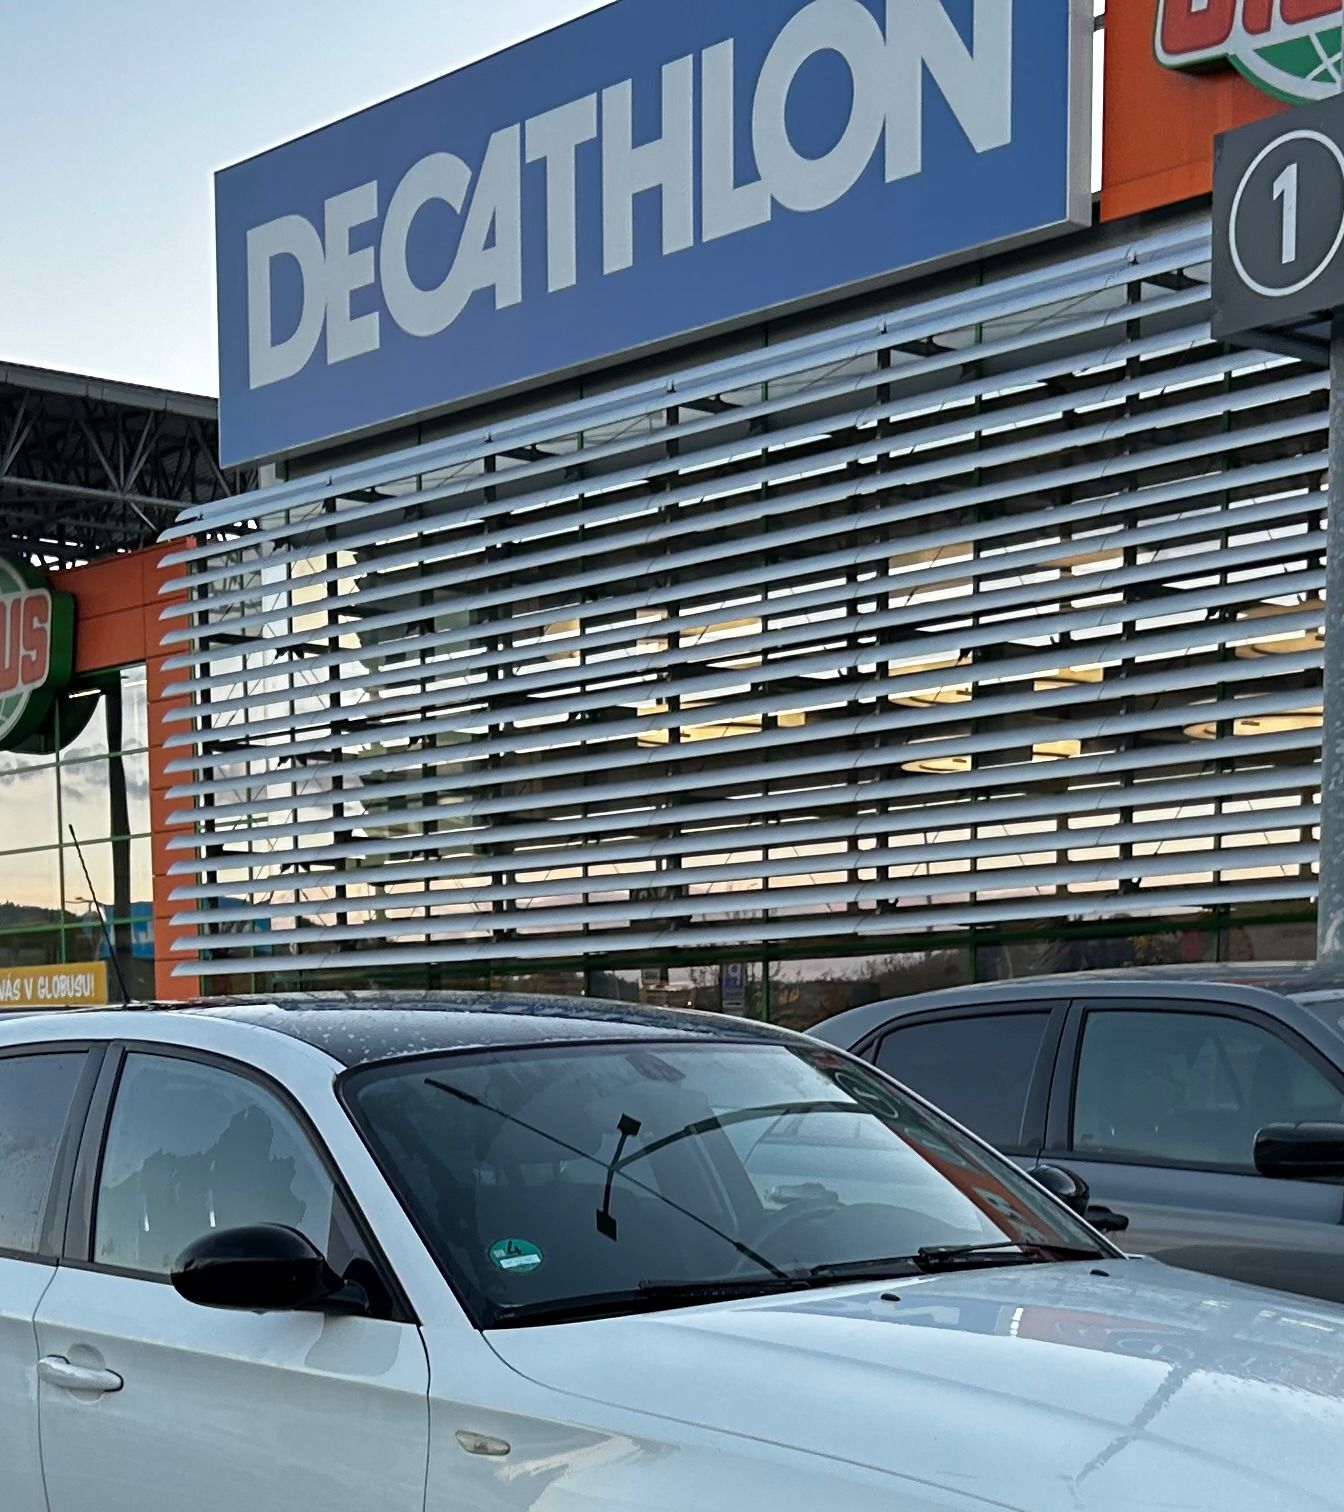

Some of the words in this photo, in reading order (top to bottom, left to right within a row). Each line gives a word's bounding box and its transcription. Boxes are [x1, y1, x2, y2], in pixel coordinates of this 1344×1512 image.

[246, 0, 1013, 391] DECATHLON
[1271, 162, 1298, 265] 1
[24, 977, 34, 1000] V
[37, 973, 95, 999] GLOBUSU!
